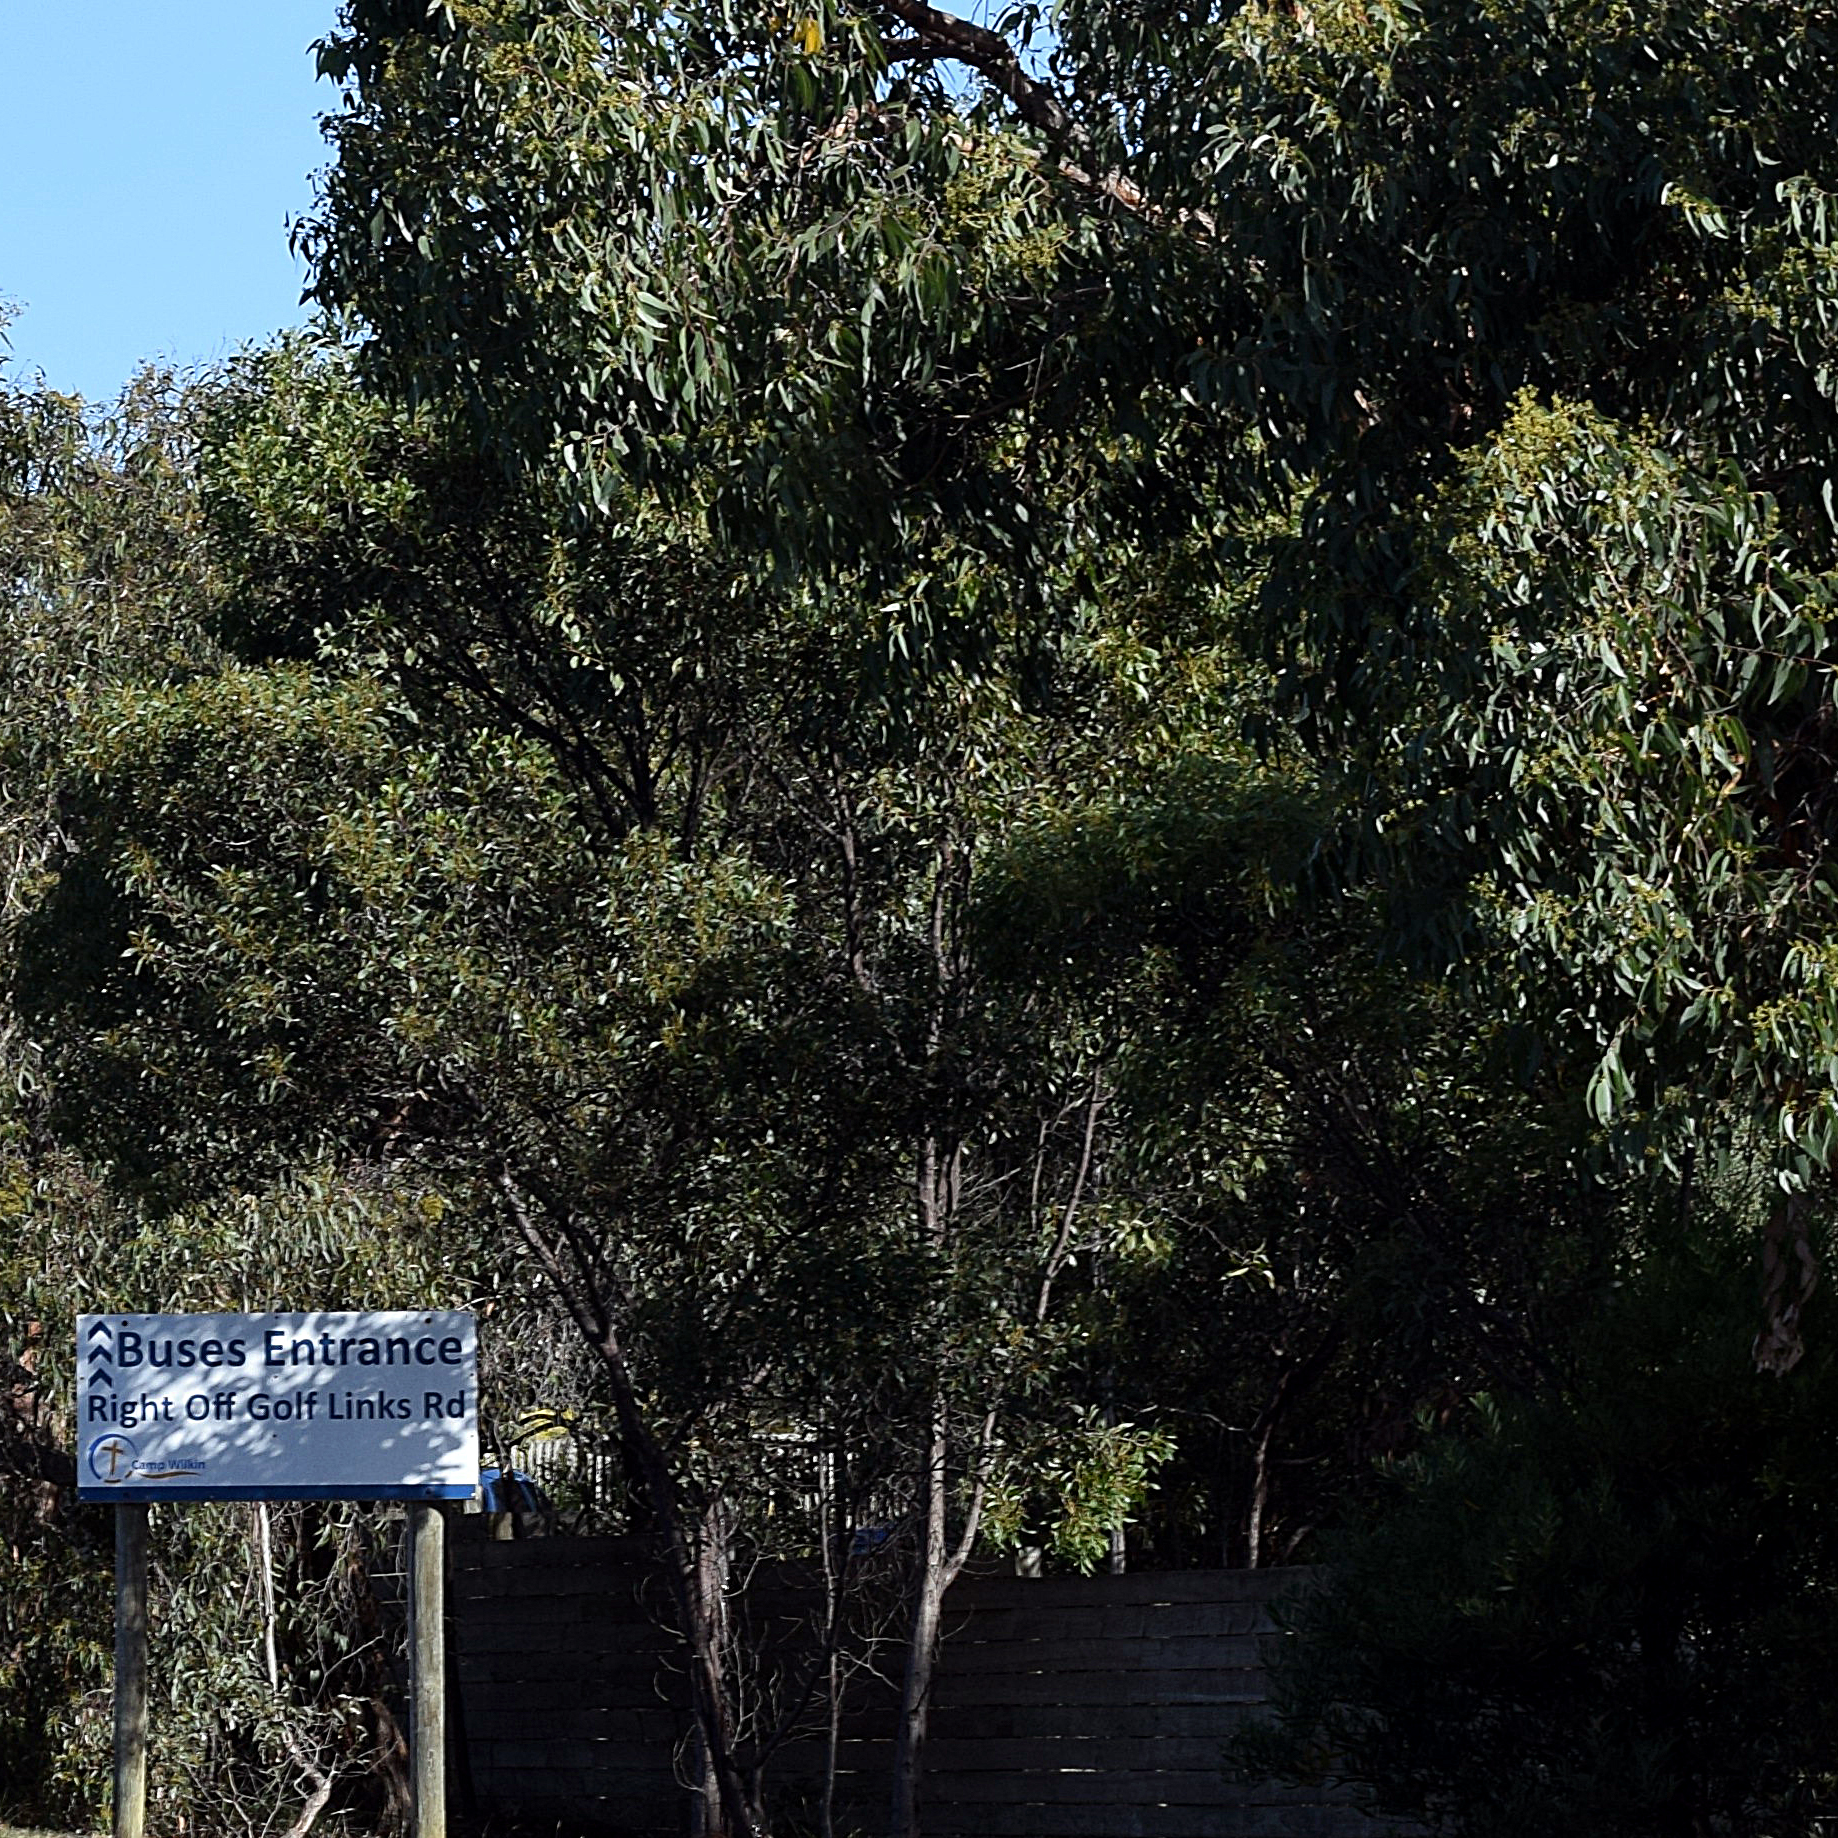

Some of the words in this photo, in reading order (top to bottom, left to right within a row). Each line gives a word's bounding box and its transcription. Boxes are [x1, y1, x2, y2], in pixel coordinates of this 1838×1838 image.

[117, 1331, 246, 1368] Buses
[264, 1329, 463, 1367] Entrance
[88, 1393, 174, 1429] Right
[186, 1392, 237, 1421] Off
[246, 1391, 319, 1421] Golf
[328, 1391, 412, 1420] Links
[424, 1390, 466, 1419] Rd
[131, 1459, 166, 1471] Camp
